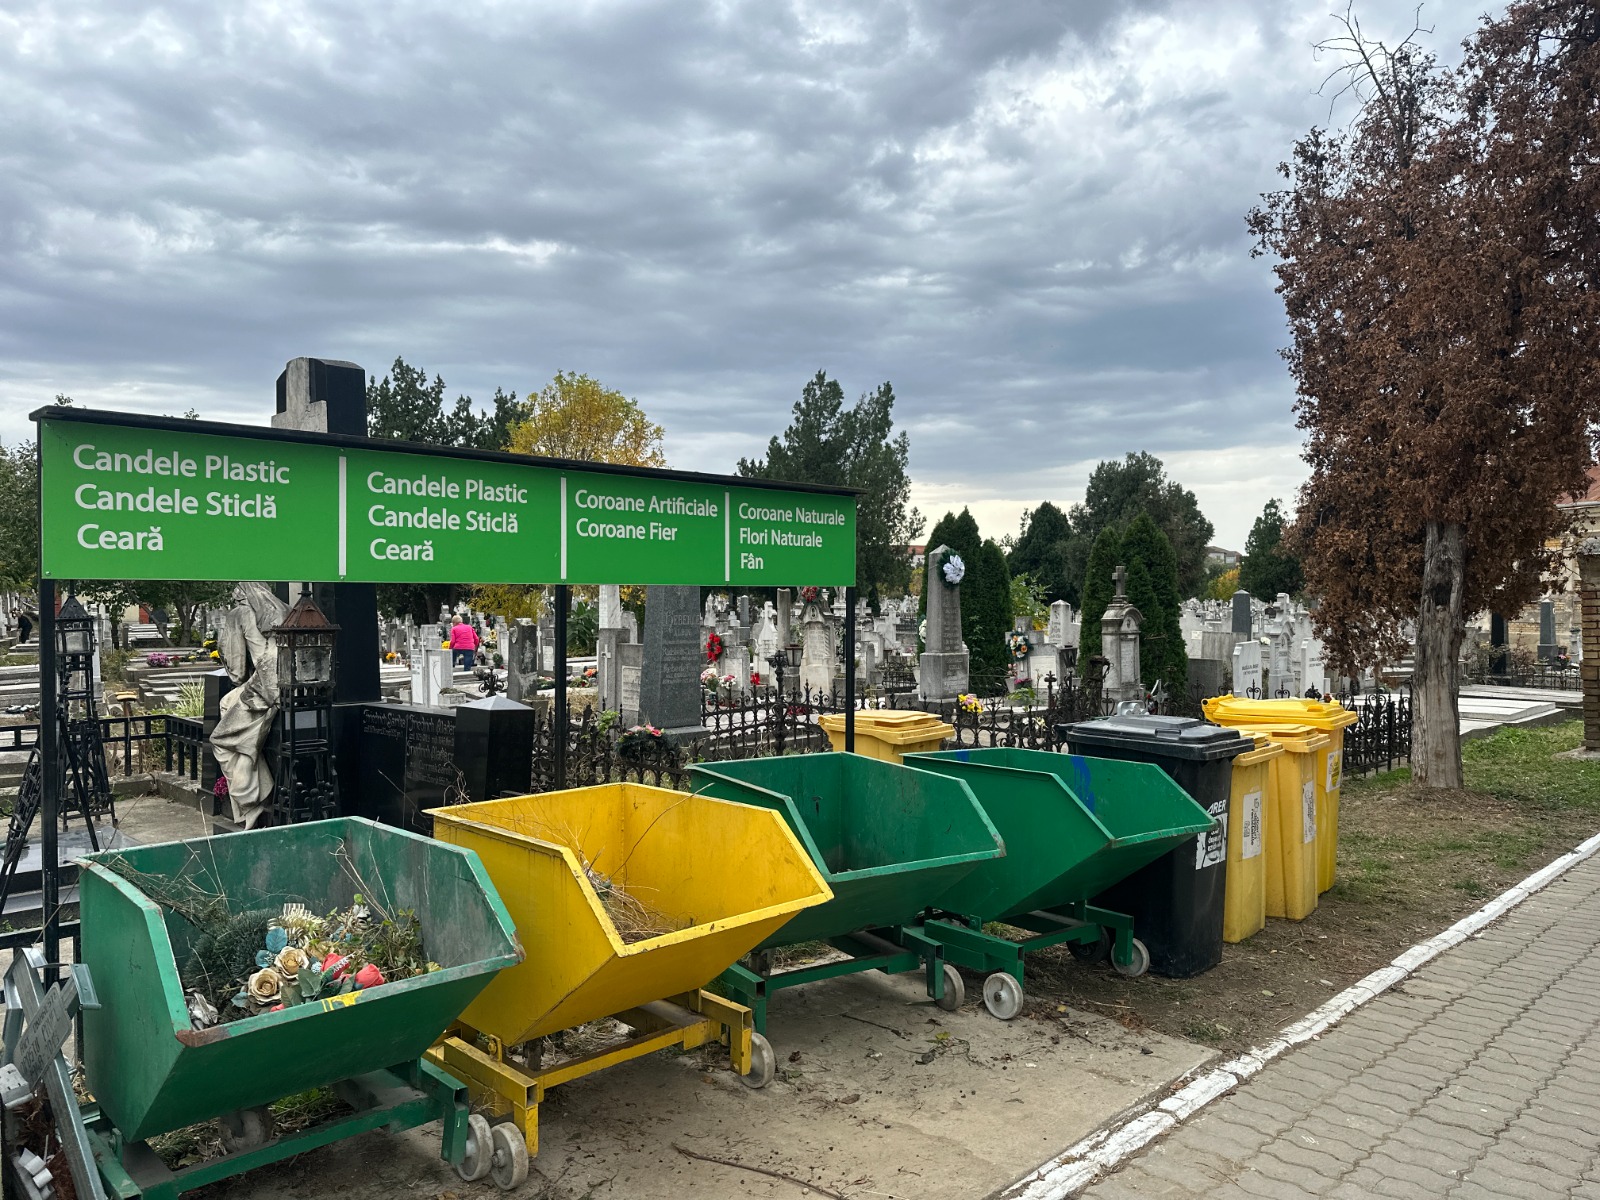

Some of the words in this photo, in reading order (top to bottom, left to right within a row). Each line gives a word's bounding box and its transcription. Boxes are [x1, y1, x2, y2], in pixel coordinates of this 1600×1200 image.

[73, 443, 198, 477] Candele
[204, 454, 290, 484] Plastic
[74, 484, 199, 515] Candele
[205, 492, 276, 519] Sticlă
[367, 471, 460, 499] Candele
[464, 479, 527, 504] Plastic
[575, 489, 645, 512] Coroane
[648, 496, 718, 517] Artificiale
[739, 503, 792, 522] Coroane
[796, 507, 845, 525] Naturale
[368, 504, 461, 530] Candele
[466, 510, 518, 533] Sticlă
[576, 518, 646, 539] Coroane
[650, 522, 677, 540] Fier
[76, 523, 163, 552] Ceară
[370, 538, 434, 561] Ceară
[740, 527, 768, 544] Flori
[771, 529, 822, 547] Naturale
[741, 553, 764, 569] Fân
